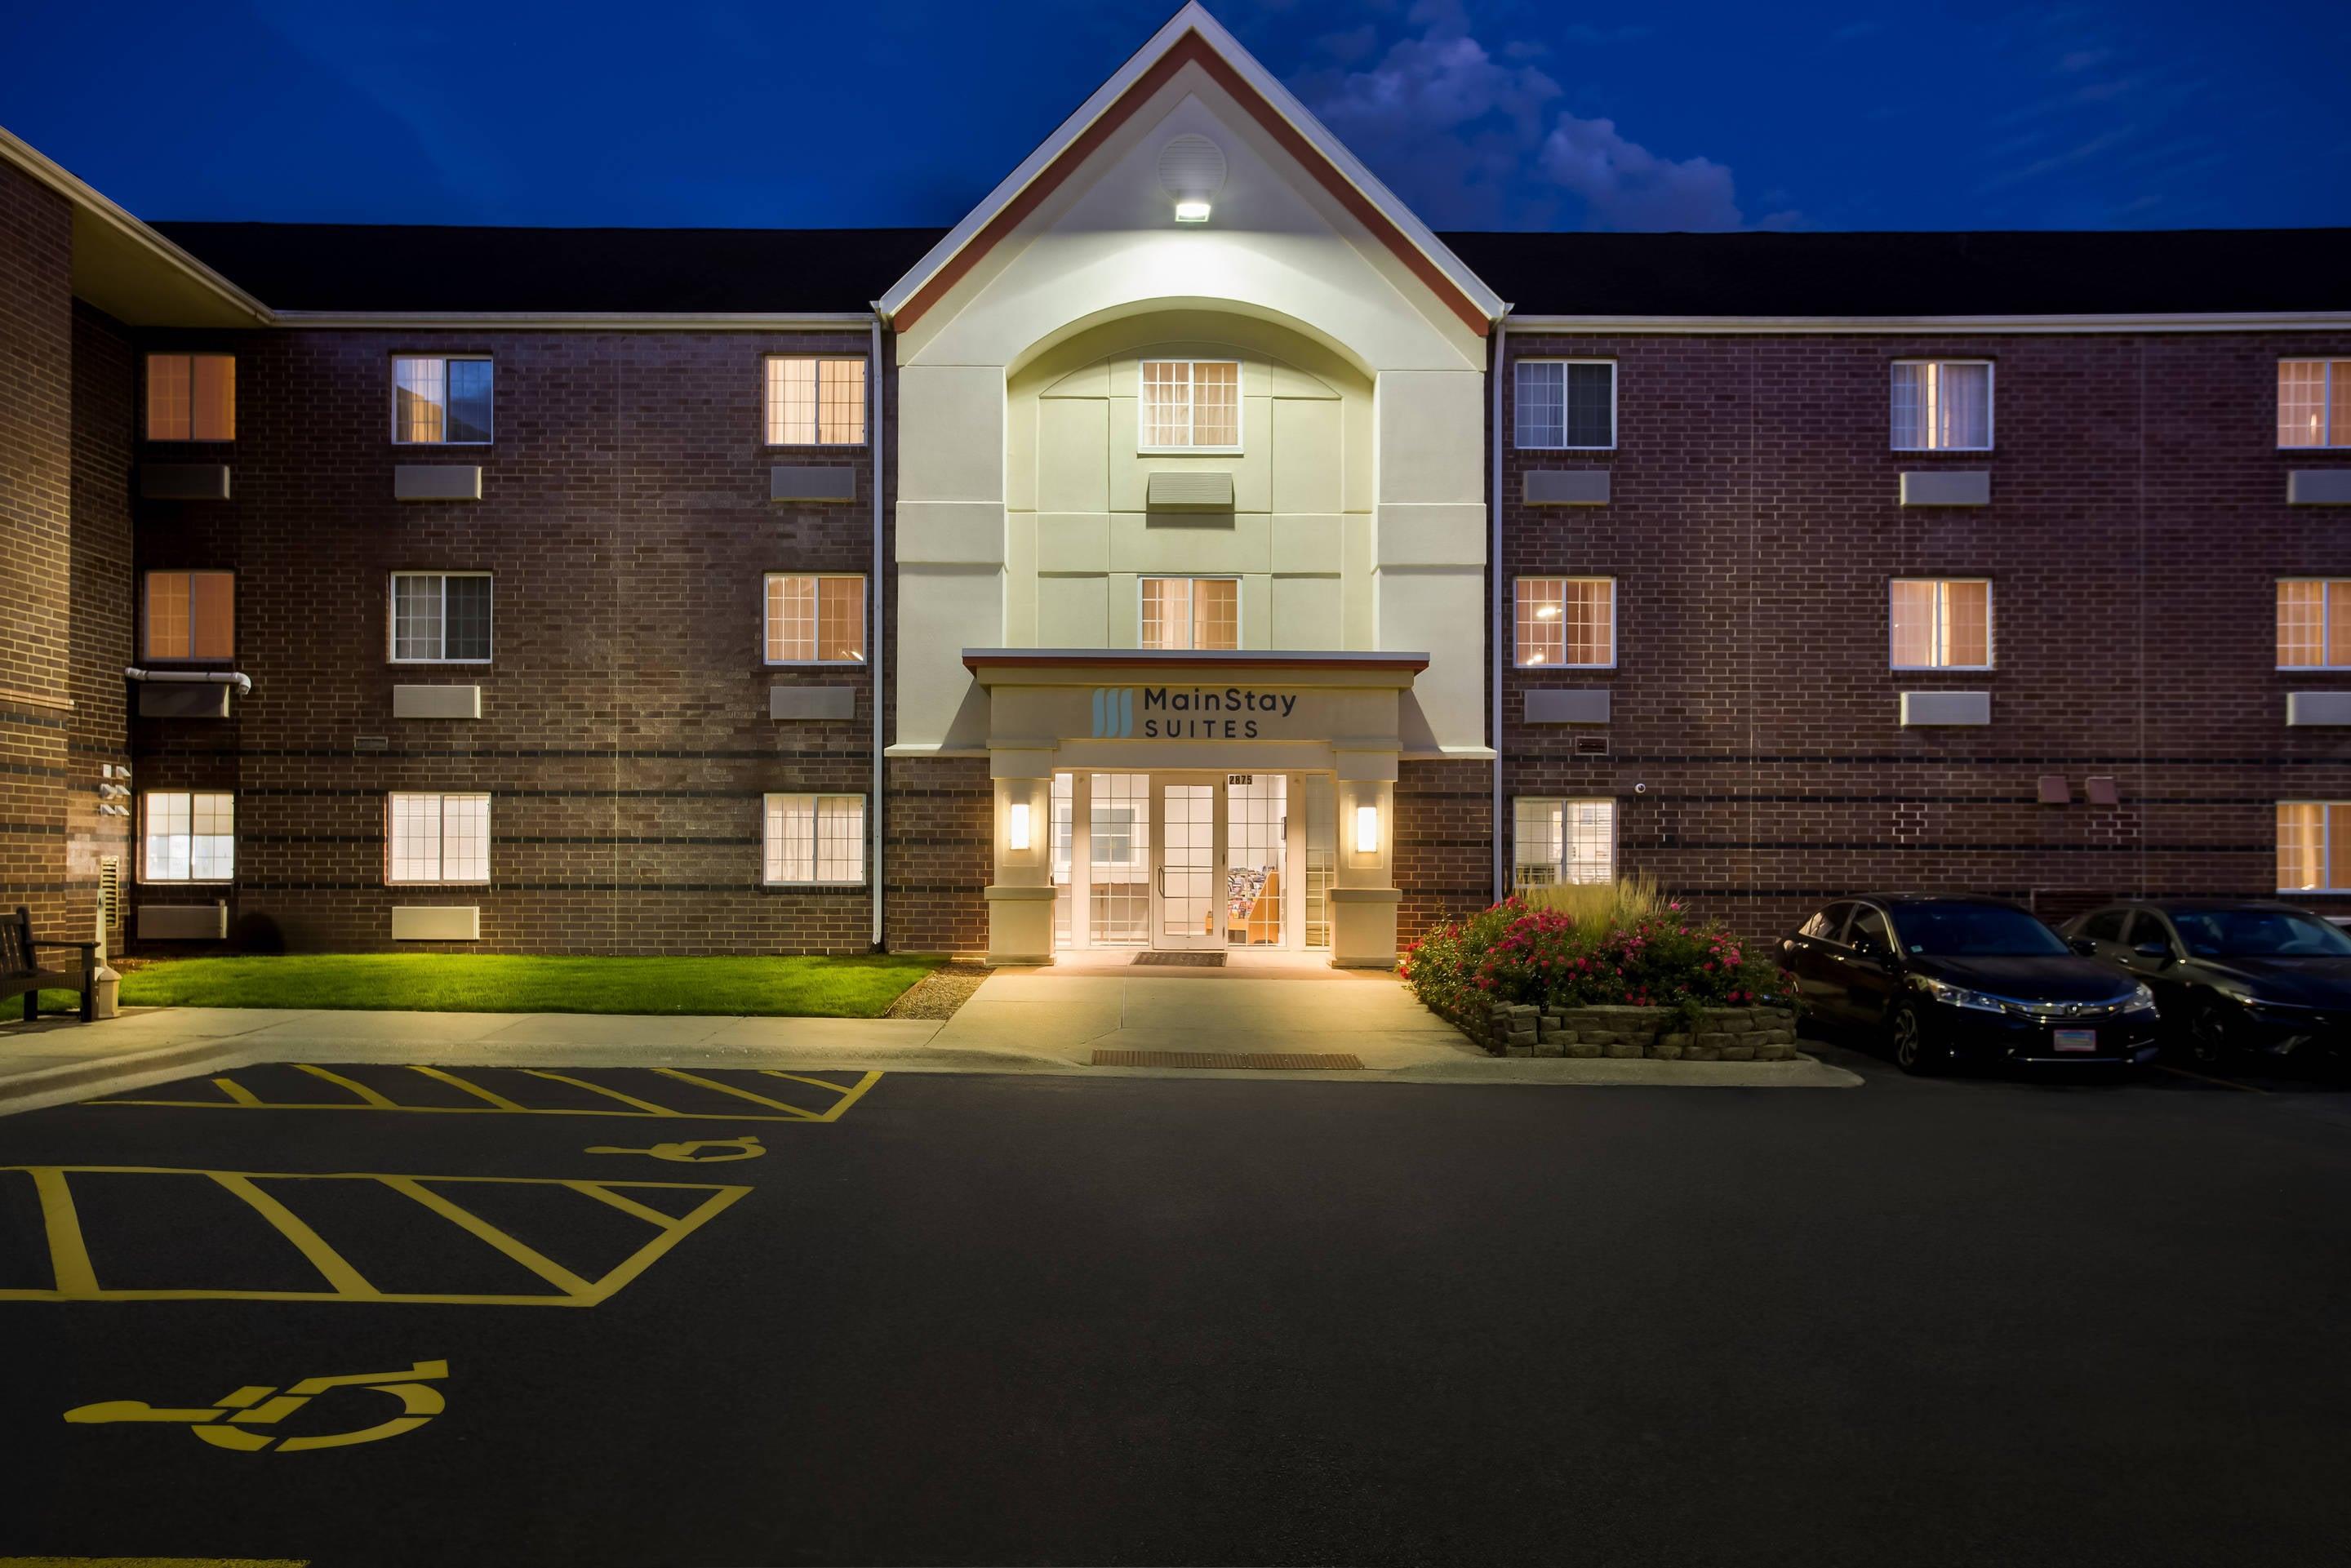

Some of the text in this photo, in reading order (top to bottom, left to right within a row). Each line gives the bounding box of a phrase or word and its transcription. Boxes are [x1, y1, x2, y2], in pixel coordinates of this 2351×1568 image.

[1144, 688, 1297, 717] MainStay
[1145, 719, 1258, 738] SUITES
[1229, 775, 1252, 784] 2875
